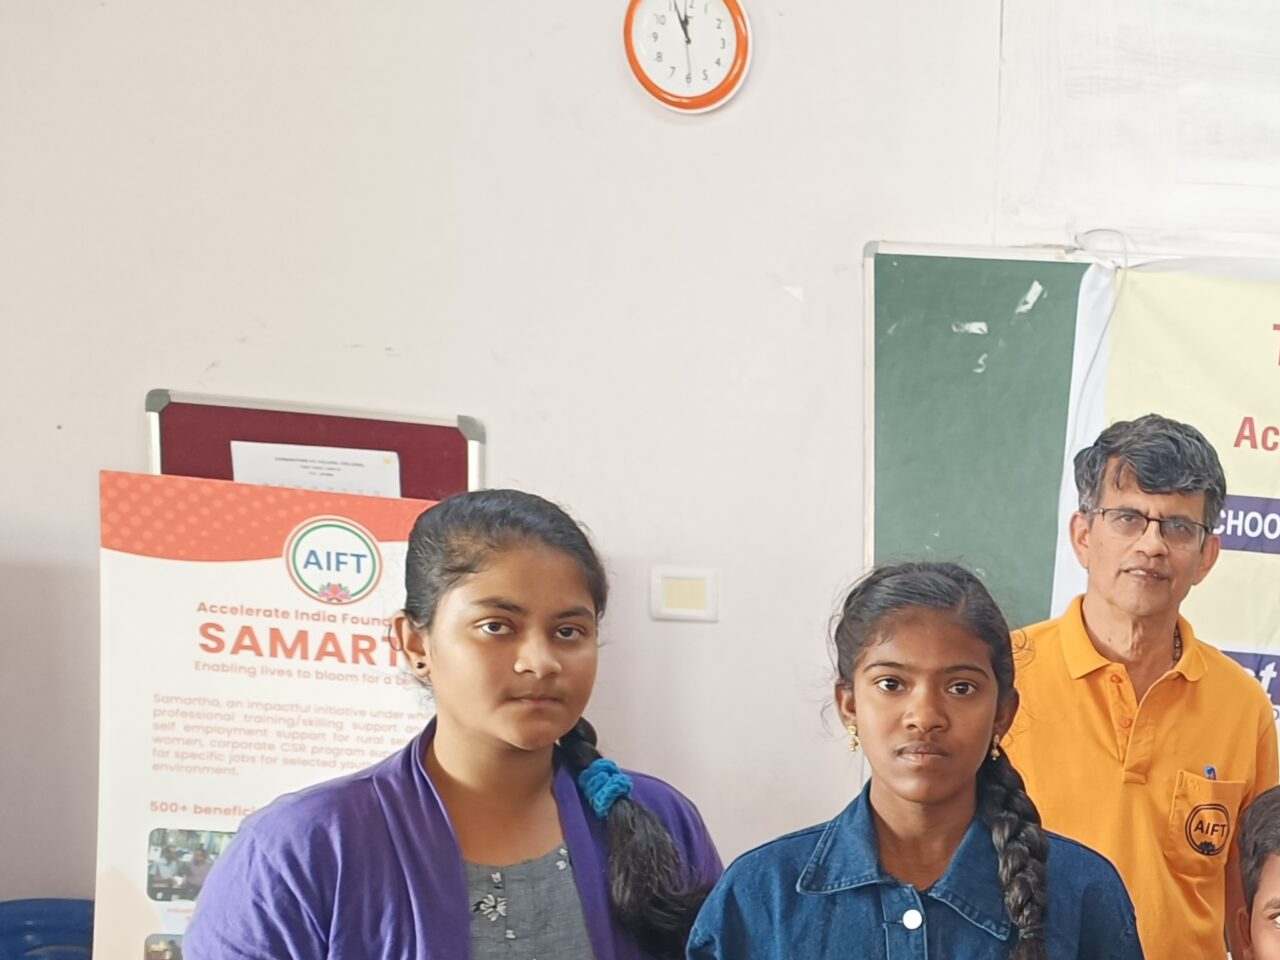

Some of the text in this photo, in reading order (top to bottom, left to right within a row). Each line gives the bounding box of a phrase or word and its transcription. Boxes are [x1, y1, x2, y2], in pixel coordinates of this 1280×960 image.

[302, 548, 368, 575] AIFT
[197, 601, 290, 620] Accelerate
[294, 609, 337, 624] India
[194, 660, 257, 677] Enabling
[261, 665, 293, 678] lives
[297, 668, 311, 679] to
[315, 670, 359, 683] bloom
[362, 673, 380, 685] for
[383, 676, 392, 686] a
[153, 707, 235, 721] professional
[183, 724, 268, 737] employment
[209, 739, 275, 751] corporate
[311, 745, 365, 758] program
[150, 800, 188, 813] 500+
[1194, 820, 1228, 838] AIFT
